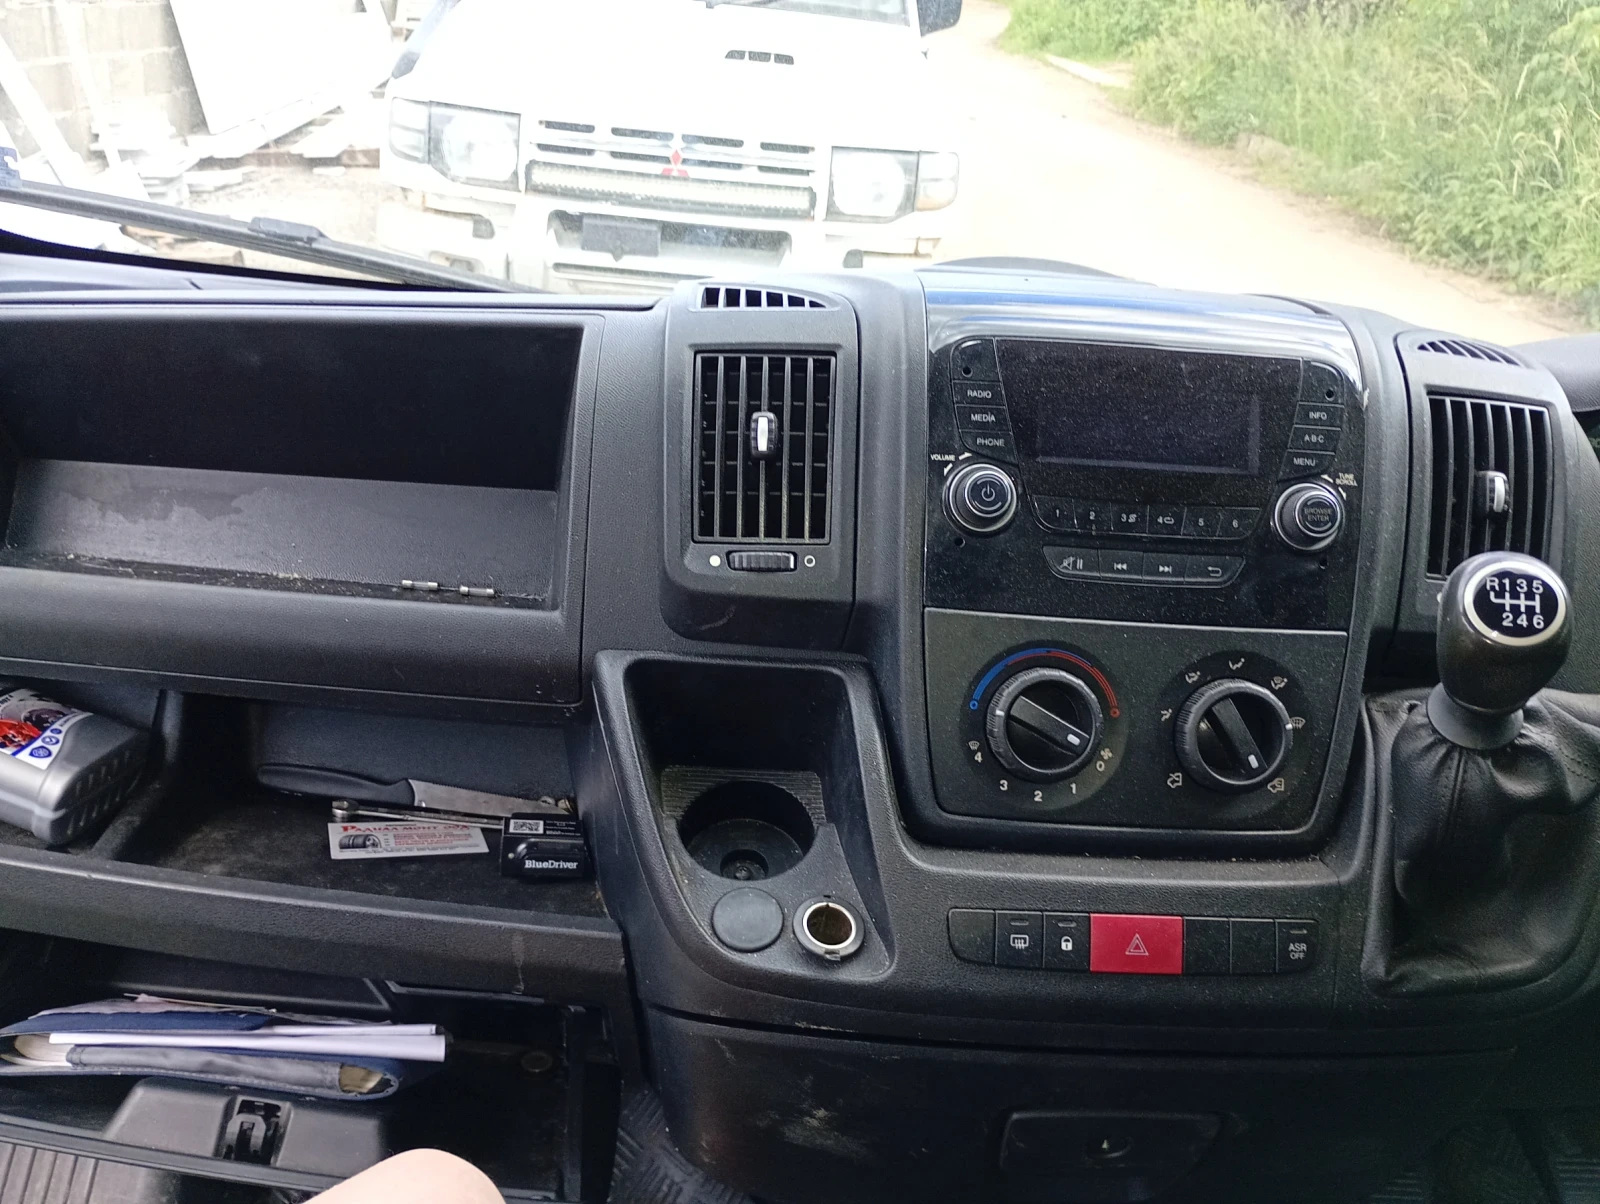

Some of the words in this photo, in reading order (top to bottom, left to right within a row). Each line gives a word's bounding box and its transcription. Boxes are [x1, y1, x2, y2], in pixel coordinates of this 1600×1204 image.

[966, 389, 993, 399] RADIO
[970, 412, 996, 423] MEDIA
[1308, 411, 1328, 421] INFO
[976, 437, 1005, 447] PHONE
[930, 453, 956, 462] VOLUME
[1293, 457, 1316, 467] MENU
[1338, 472, 1355, 480] TUNE
[1335, 477, 1359, 487] SCROLL
[1304, 506, 1333, 515] BROWSE
[1089, 510, 1097, 521] 2
[1197, 517, 1205, 527] 5
[1232, 519, 1239, 528] 6
[1306, 514, 1330, 522] ENTER
[1485, 577, 1500, 591] R
[1502, 577, 1511, 592] 1
[1516, 578, 1529, 593] 3
[1532, 580, 1544, 594] 5
[1501, 612, 1514, 627] 2
[1516, 613, 1529, 628] 4
[1532, 615, 1545, 629] 6
[974, 752, 983, 763] 4
[999, 779, 1008, 791] 3
[1070, 782, 1077, 795] 1
[1033, 790, 1043, 802] 2
[524, 859, 579, 869] BlueDriver
[1288, 942, 1307, 952] ASR
[1289, 951, 1306, 960] OFF
